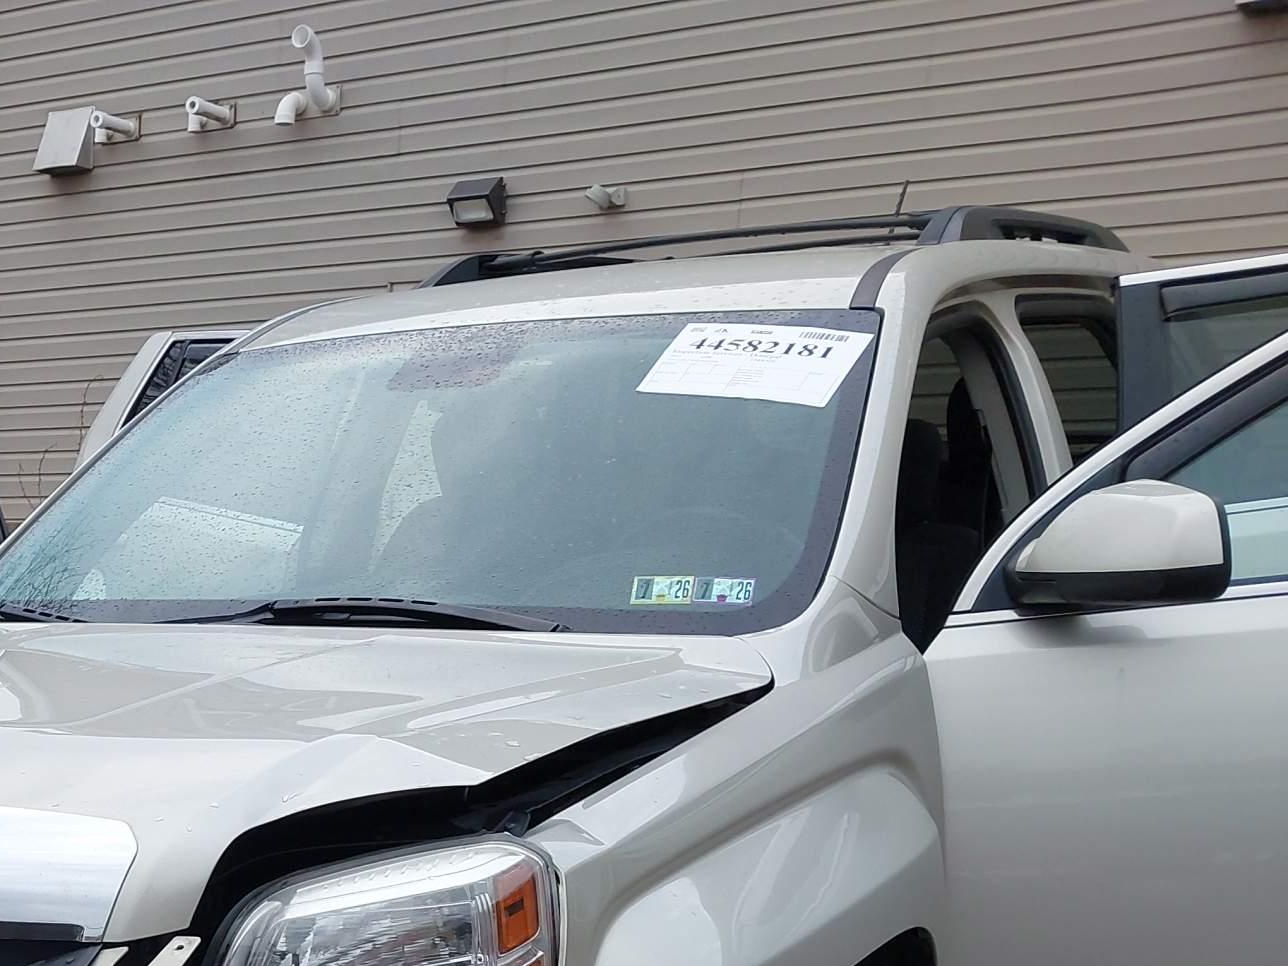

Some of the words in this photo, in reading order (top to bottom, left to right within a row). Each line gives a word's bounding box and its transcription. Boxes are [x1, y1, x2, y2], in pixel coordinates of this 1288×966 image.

[689, 336, 835, 359] 44582181
[674, 580, 691, 599] 26
[735, 581, 752, 601] 26
